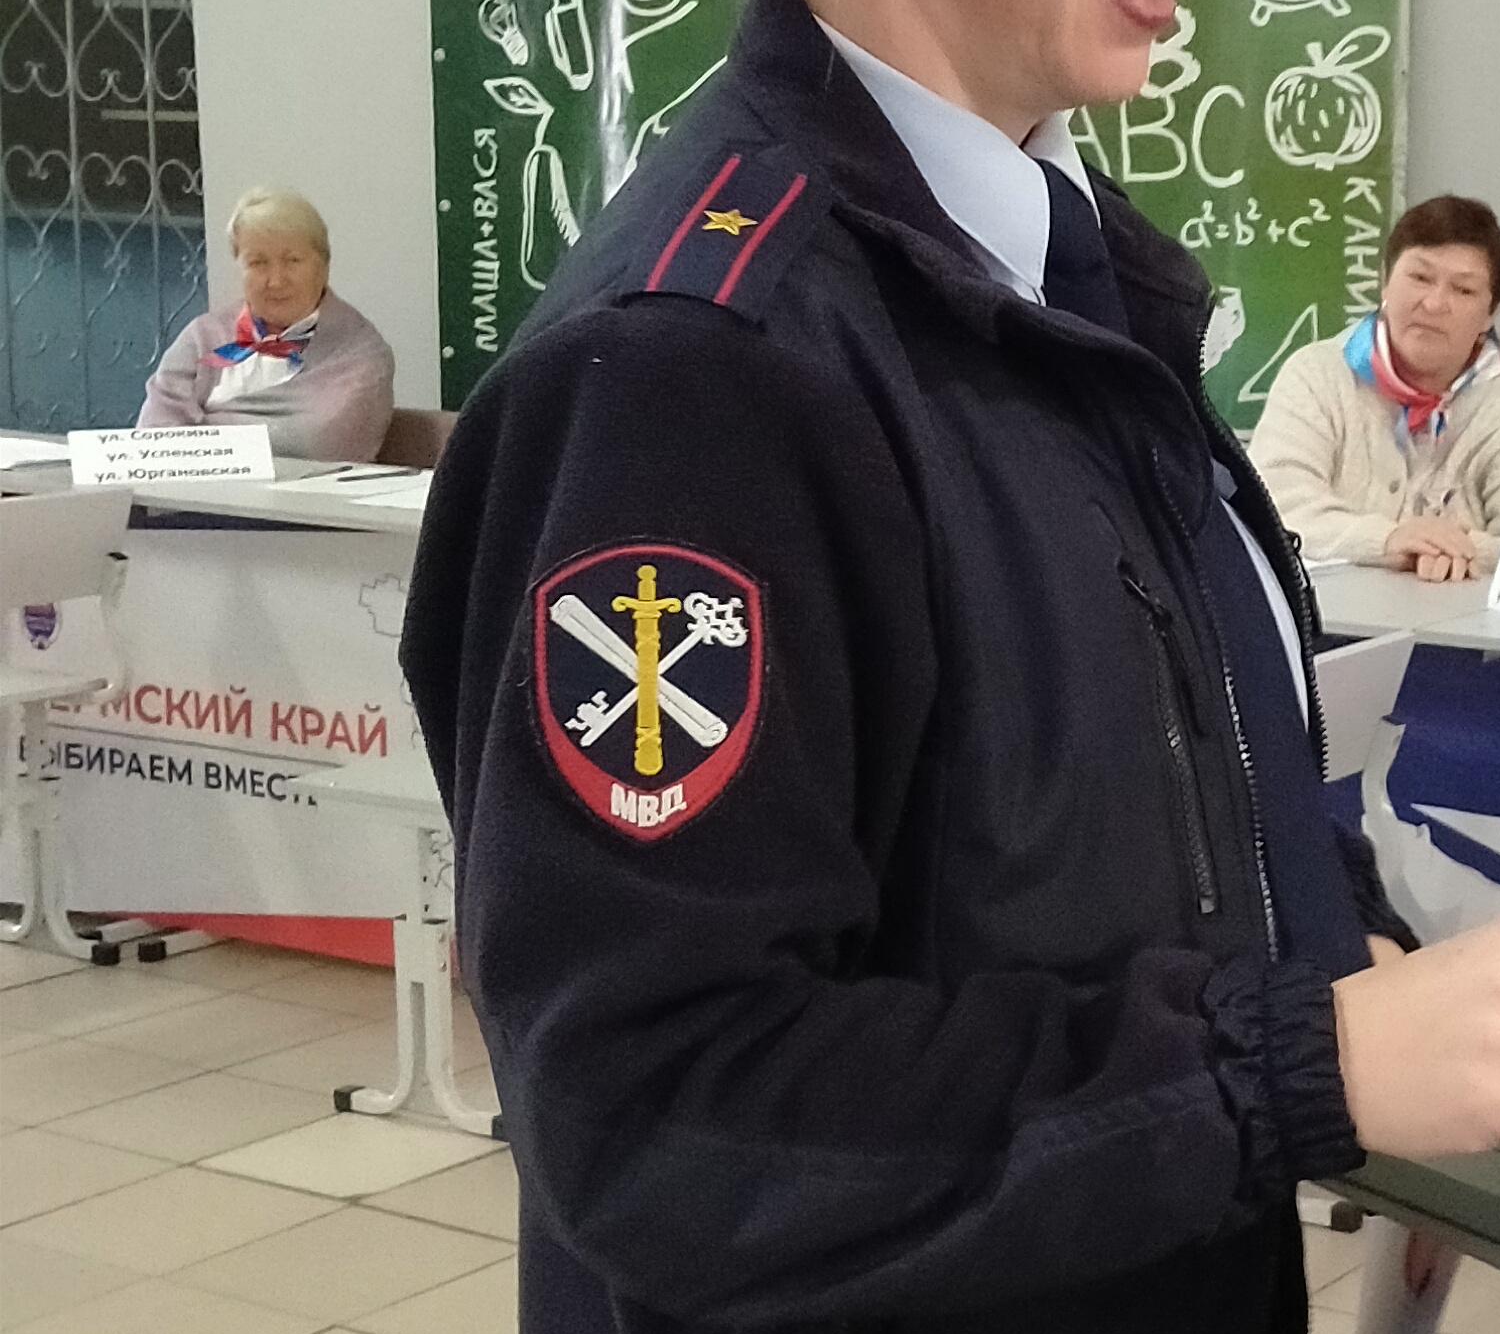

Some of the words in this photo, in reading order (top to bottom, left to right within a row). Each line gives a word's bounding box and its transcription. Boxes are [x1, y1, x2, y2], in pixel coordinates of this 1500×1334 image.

[472, 128, 499, 353] МАША+ВАСЯ
[1343, 176, 1382, 325] КАНИ
[131, 428, 220, 442] Сорокина
[138, 447, 234, 460] Успенская
[128, 466, 251, 480] Юргановская
[270, 702, 389, 758] КРАЙ
[611, 782, 687, 827] МВД
